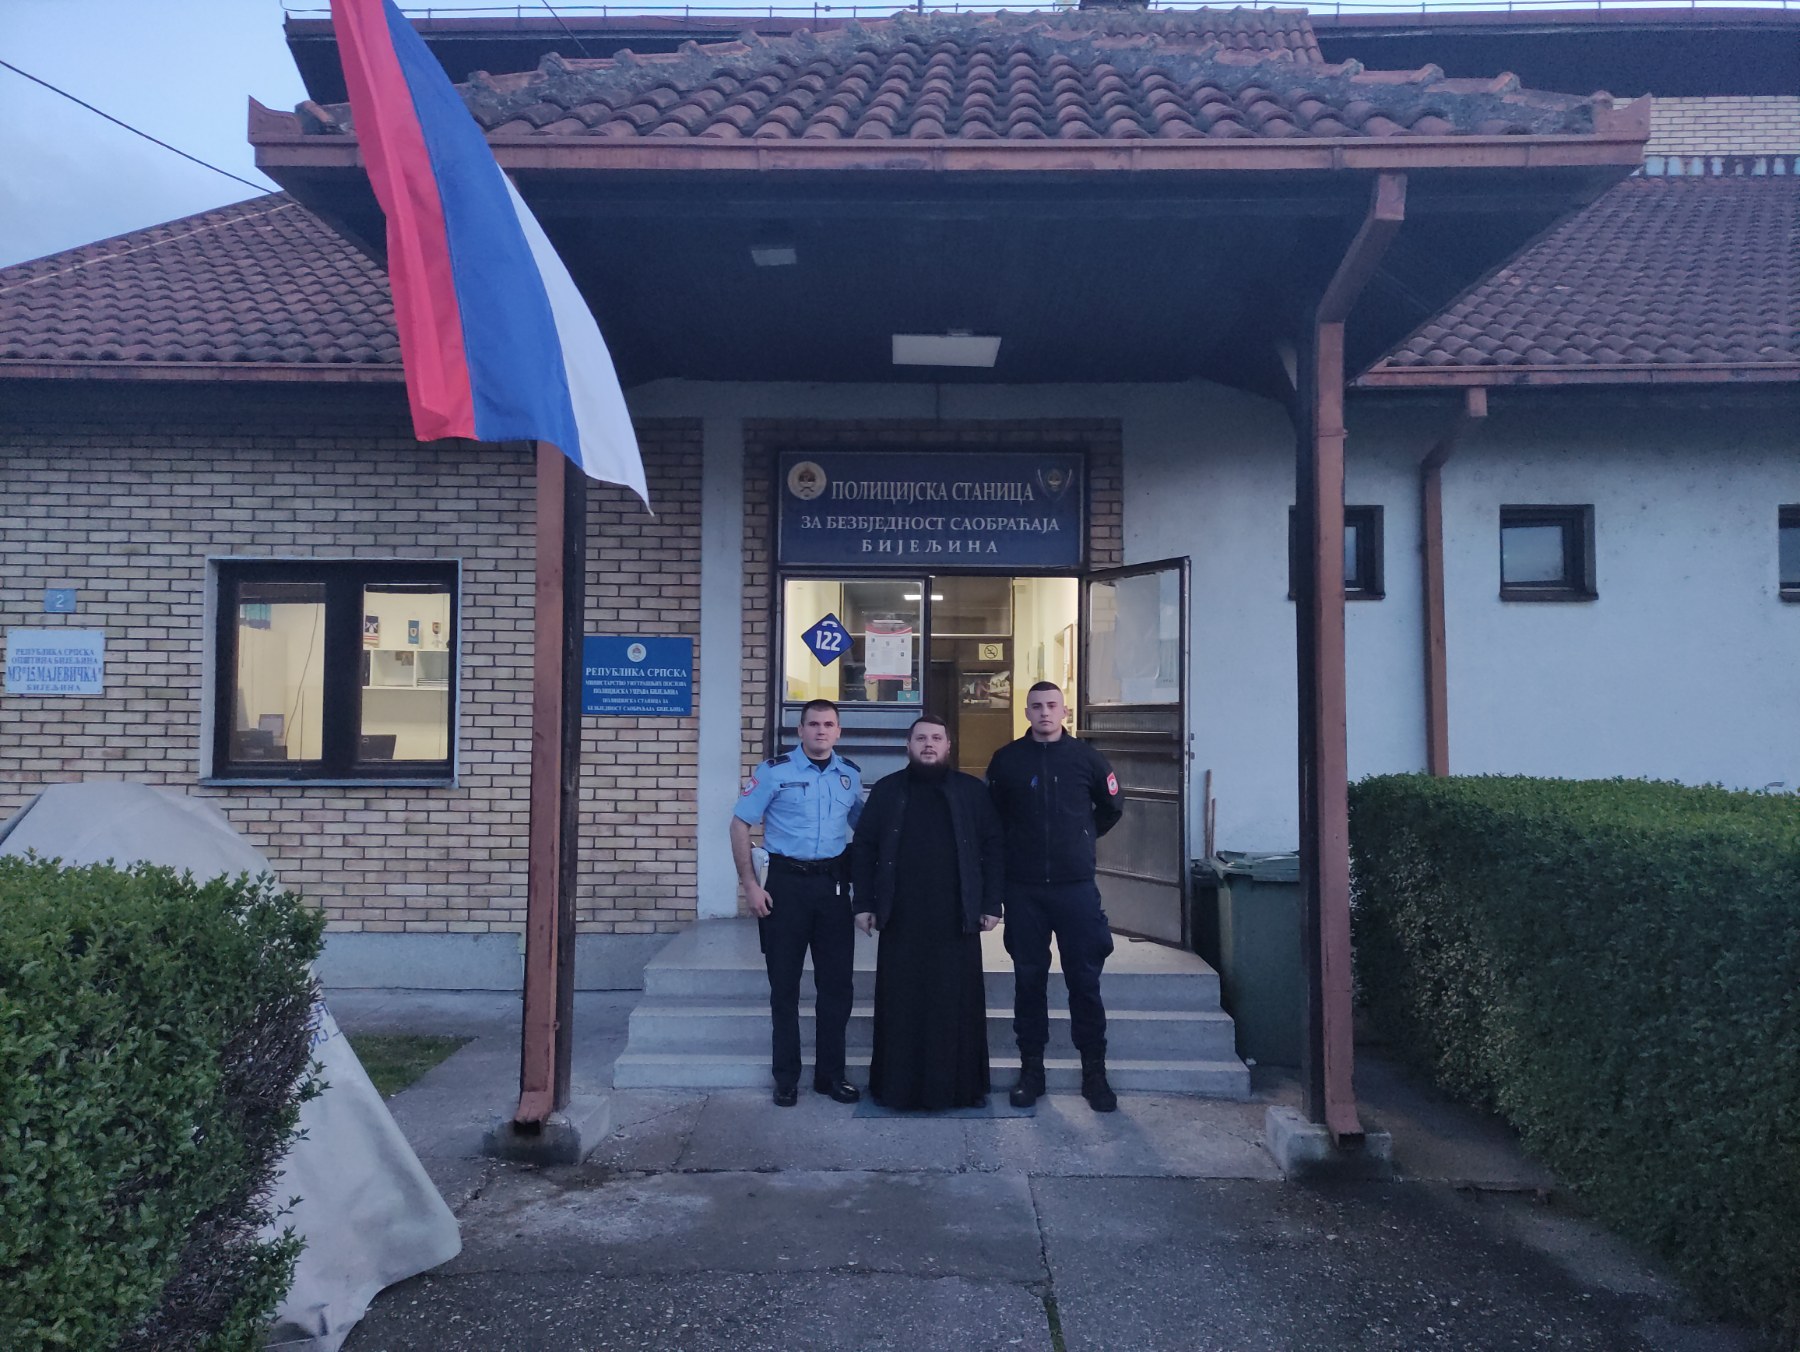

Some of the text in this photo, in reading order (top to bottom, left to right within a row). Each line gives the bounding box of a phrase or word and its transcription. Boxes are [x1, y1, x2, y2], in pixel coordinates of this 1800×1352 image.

[831, 480, 1035, 505] ПОЛИЦИЈСКА СТАНИЦА
[801, 515, 1060, 534] ЗА БЕЗБЈЕДНОСТ САОБРАЋАЈА
[861, 539, 998, 556] БИЈЕЉИНА
[55, 594, 65, 608] 2
[815, 630, 842, 652] 122
[585, 667, 687, 678] РЕПУБЛИКА СРПСКА
